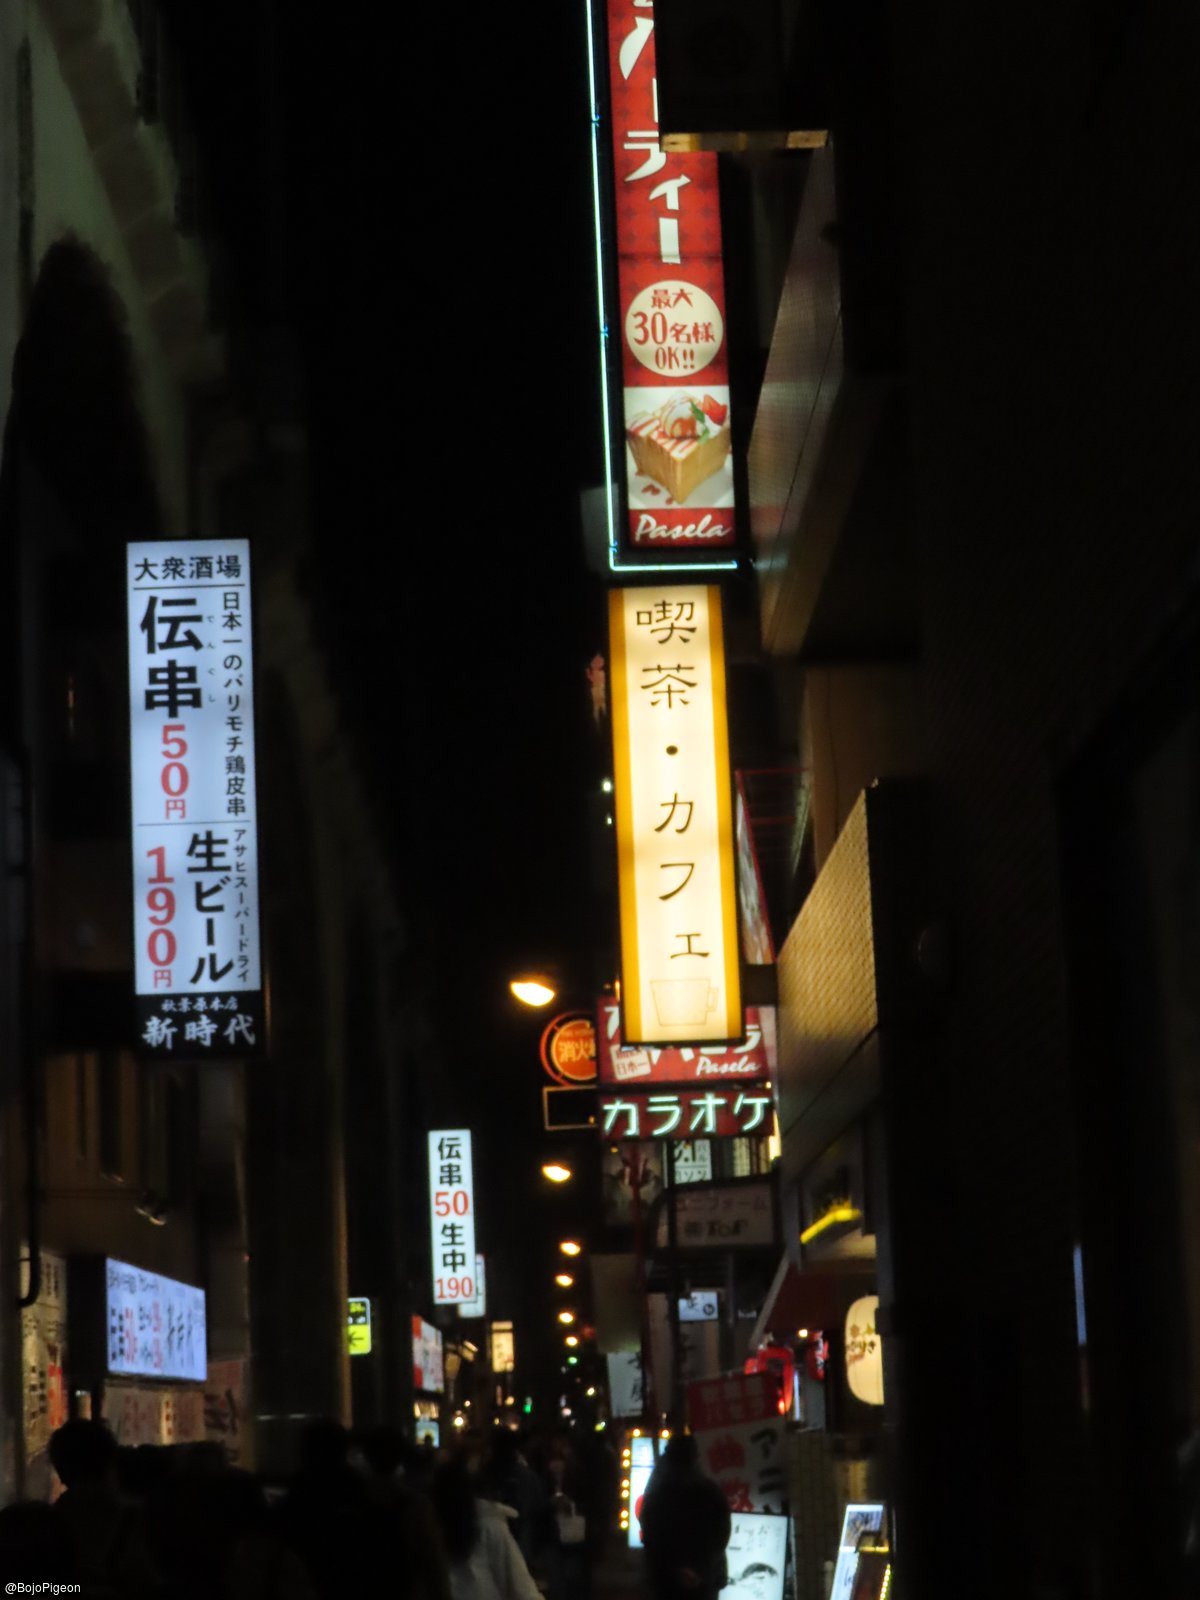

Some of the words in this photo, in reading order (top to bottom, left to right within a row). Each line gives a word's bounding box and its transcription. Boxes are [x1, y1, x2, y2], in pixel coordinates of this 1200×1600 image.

[651, 288, 693, 309] 最大
[632, 311, 716, 346] 30名様
[655, 346, 695, 370] OK!!
[635, 514, 733, 542] Pasela
[134, 555, 242, 582] 大衆酒場
[140, 595, 204, 719] 伝串
[222, 591, 247, 817] 日本一のパリモチ鶏皮串
[161, 724, 190, 820] 50円
[145, 845, 177, 989] 190円
[186, 829, 235, 985] 生ビール
[233, 828, 250, 983] アサヒスーパードライ
[141, 1013, 257, 1050] 新時代
[696, 1056, 761, 1077] Pasela
[602, 1092, 770, 1137] カラオケ
[437, 1136, 463, 1187] 伝串
[434, 1190, 470, 1217] 50
[440, 1223, 466, 1273] 生中
[434, 1276, 474, 1301] 190
